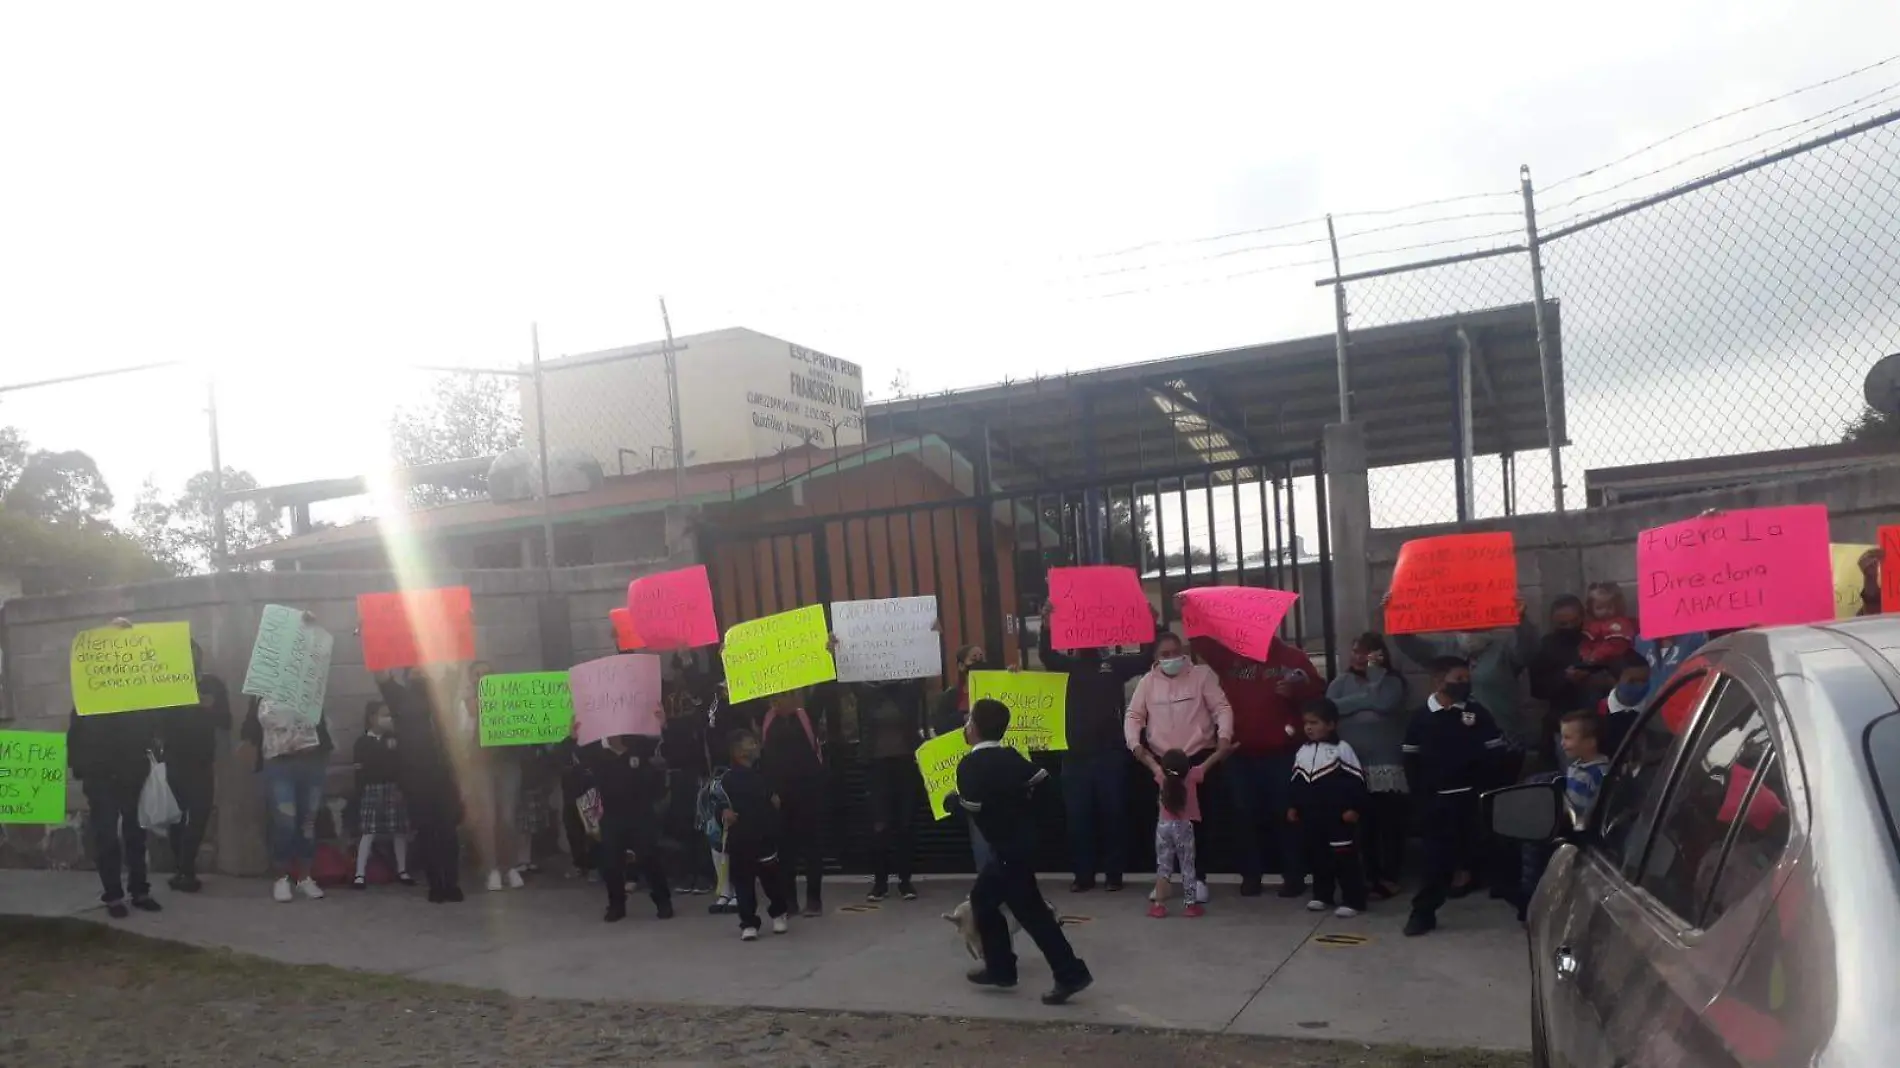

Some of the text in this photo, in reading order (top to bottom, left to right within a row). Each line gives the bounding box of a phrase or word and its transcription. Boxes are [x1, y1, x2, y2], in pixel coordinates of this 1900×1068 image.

[1647, 522, 1728, 554] Fuera
[1649, 561, 1768, 599] Directora
[139, 647, 157, 662] de
